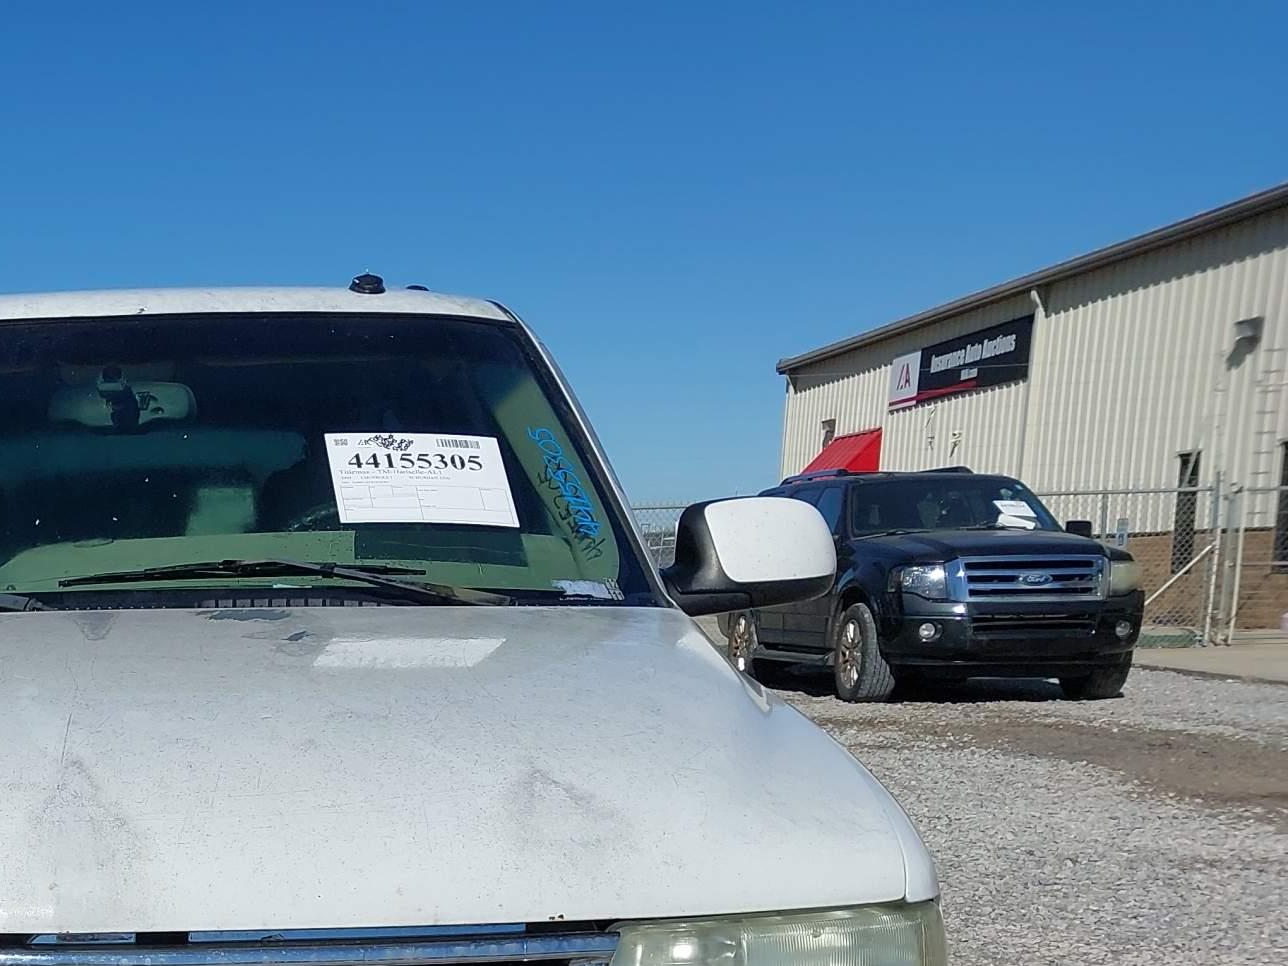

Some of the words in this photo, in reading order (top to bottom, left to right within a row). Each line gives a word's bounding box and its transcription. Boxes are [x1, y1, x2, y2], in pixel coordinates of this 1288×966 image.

[931, 349, 966, 373] Insurance
[965, 343, 982, 364] Auto
[982, 334, 1016, 359] Auctions
[348, 453, 483, 471] 44155305
